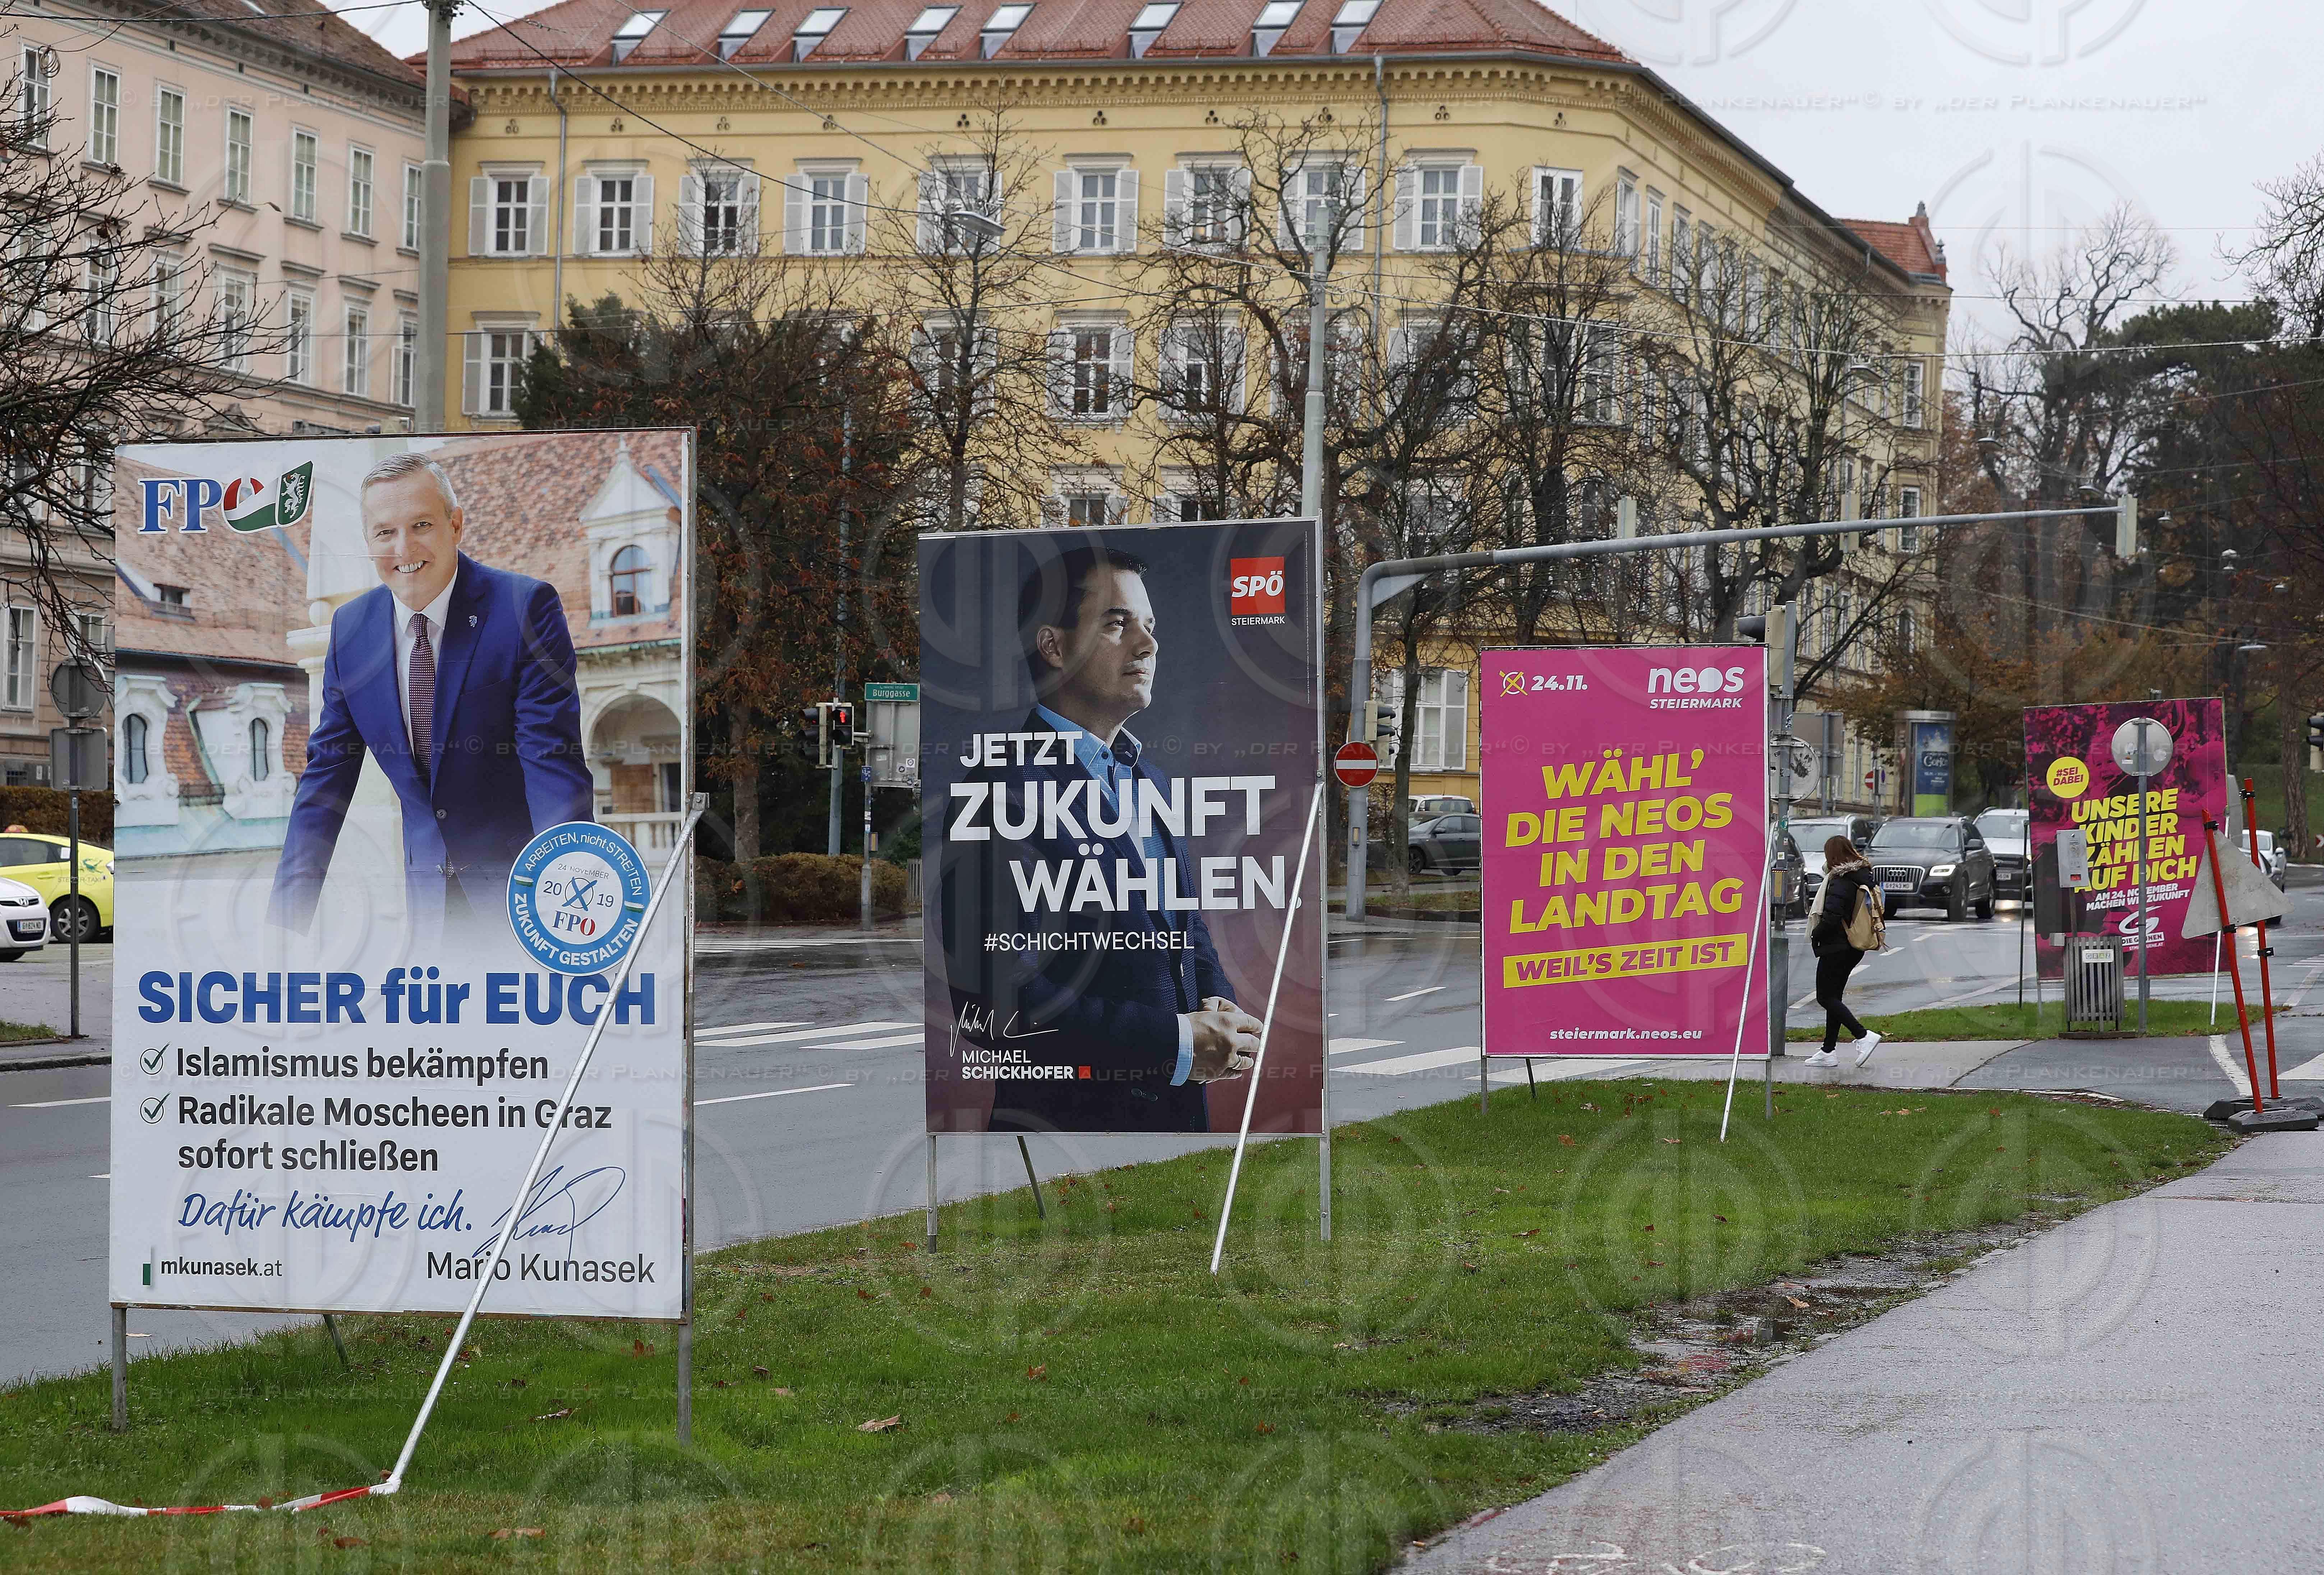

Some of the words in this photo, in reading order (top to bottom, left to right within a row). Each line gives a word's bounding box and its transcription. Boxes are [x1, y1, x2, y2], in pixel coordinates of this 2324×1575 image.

[1231, 571, 1284, 599] SPÖ
[1231, 615, 1285, 625] STEIERMARK
[873, 689, 910, 698] Burggasse
[1531, 674, 1588, 691] 24.11.
[1647, 666, 1745, 694] neos
[1649, 698, 1742, 710] STEIERMARK
[960, 731, 1082, 767] JETZT
[2053, 773, 2084, 786] DABEI
[2056, 767, 2078, 777] #SEI
[950, 775, 1276, 841] ZUKUNFT
[1505, 806, 1587, 847] DIE
[1598, 792, 1733, 839] NEOS
[2071, 788, 2178, 823] UNSERE
[2079, 812, 2178, 844] KINDER
[525, 832, 578, 871] ARBEITEN,
[581, 833, 607, 849] nicht
[607, 842, 642, 896] STREITEN
[1009, 842, 1302, 913] WÄHLEN.
[1539, 848, 1589, 887] IN
[1602, 839, 1706, 882] DEN
[543, 881, 562, 896] 20
[597, 893, 614, 907] 19
[1509, 877, 1744, 934] LANDTAG
[2086, 897, 2126, 911] MACHEN
[2127, 895, 2139, 906] WI
[2146, 889, 2191, 903] ZUKUNFT
[2095, 891, 2110, 902] AM
[2111, 889, 2126, 900] 24.
[515, 893, 559, 959] ZUKUNFT
[559, 918, 639, 965] GESTALTEN
[984, 931, 1195, 952] #SCHICHTWECHSEL
[1619, 946, 1683, 972] ZEIT
[1690, 941, 1737, 965] IST
[138, 969, 367, 1024] SICHER
[381, 966, 469, 1025] für
[486, 972, 655, 1026] EUCH
[1549, 1027, 1702, 1040] steiermark.neos.eu
[177, 1046, 358, 1078] Islamismus
[366, 1046, 547, 1080] bekämpfen
[962, 1050, 1031, 1064] MICHAEL
[962, 1066, 1074, 1080] SCHICKHOFER
[179, 1095, 314, 1126] Radikale
[324, 1098, 490, 1127] Moscheen
[498, 1098, 525, 1127] in
[534, 1100, 612, 1129] Graz
[179, 1139, 273, 1171] sofort
[281, 1141, 438, 1172] schließen
[179, 1190, 276, 1234] Dafür
[282, 1191, 409, 1242] kämpfe
[418, 1190, 472, 1231] ich.
[160, 1257, 282, 1278] mkunasek.at
[426, 1251, 511, 1281] Mario
[521, 1254, 655, 1283] Kunasek
